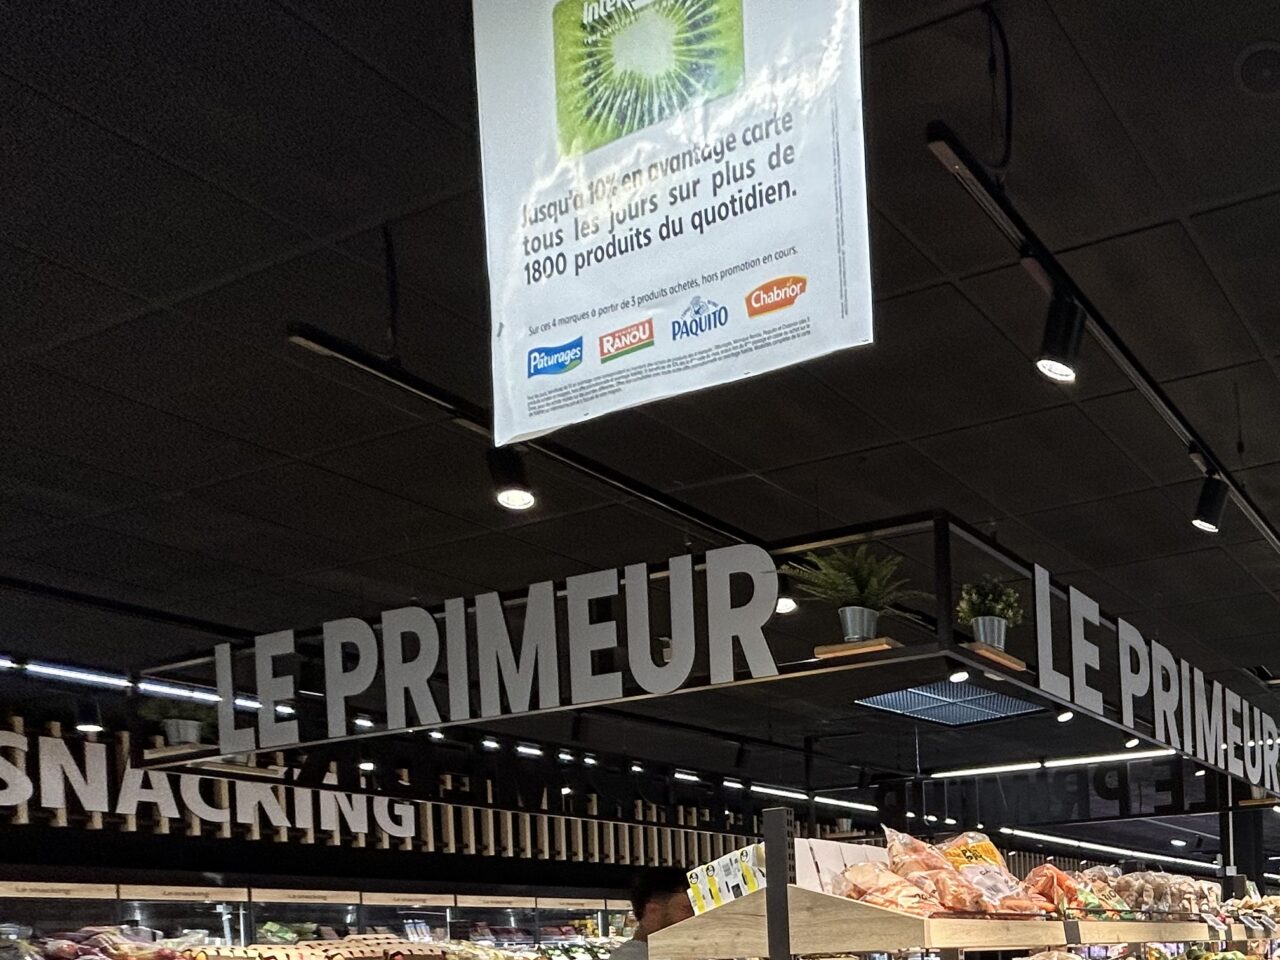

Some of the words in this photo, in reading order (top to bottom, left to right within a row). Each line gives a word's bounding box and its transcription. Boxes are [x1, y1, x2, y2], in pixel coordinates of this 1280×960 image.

[522, 228, 564, 256] tous
[574, 216, 600, 241] les
[607, 193, 658, 235] jours
[668, 177, 700, 206] sur
[711, 158, 756, 197] plus
[767, 143, 795, 171] de
[588, 173, 618, 205] 10%
[621, 168, 642, 192] en
[647, 131, 737, 182] avantage
[741, 111, 793, 147] carte
[523, 252, 567, 285] 1800
[574, 227, 652, 277] produits
[658, 214, 684, 242] du
[690, 178, 797, 235] quotidien.
[557, 310, 590, 328] marques
[598, 302, 619, 319] partir
[637, 287, 669, 308] produits
[700, 270, 720, 285] hors
[719, 257, 761, 280] promotion
[762, 253, 773, 264] en
[774, 245, 799, 261] cours.
[671, 305, 729, 342] PAQUITO
[529, 345, 582, 374] Pâturages
[602, 321, 650, 354] RANOU
[214, 629, 303, 755] LE
[322, 544, 780, 738] PRIMEUR
[1033, 562, 1105, 716] LE
[1117, 617, 1280, 793] PRIMEUR
[0, 729, 417, 838] SNACKING
